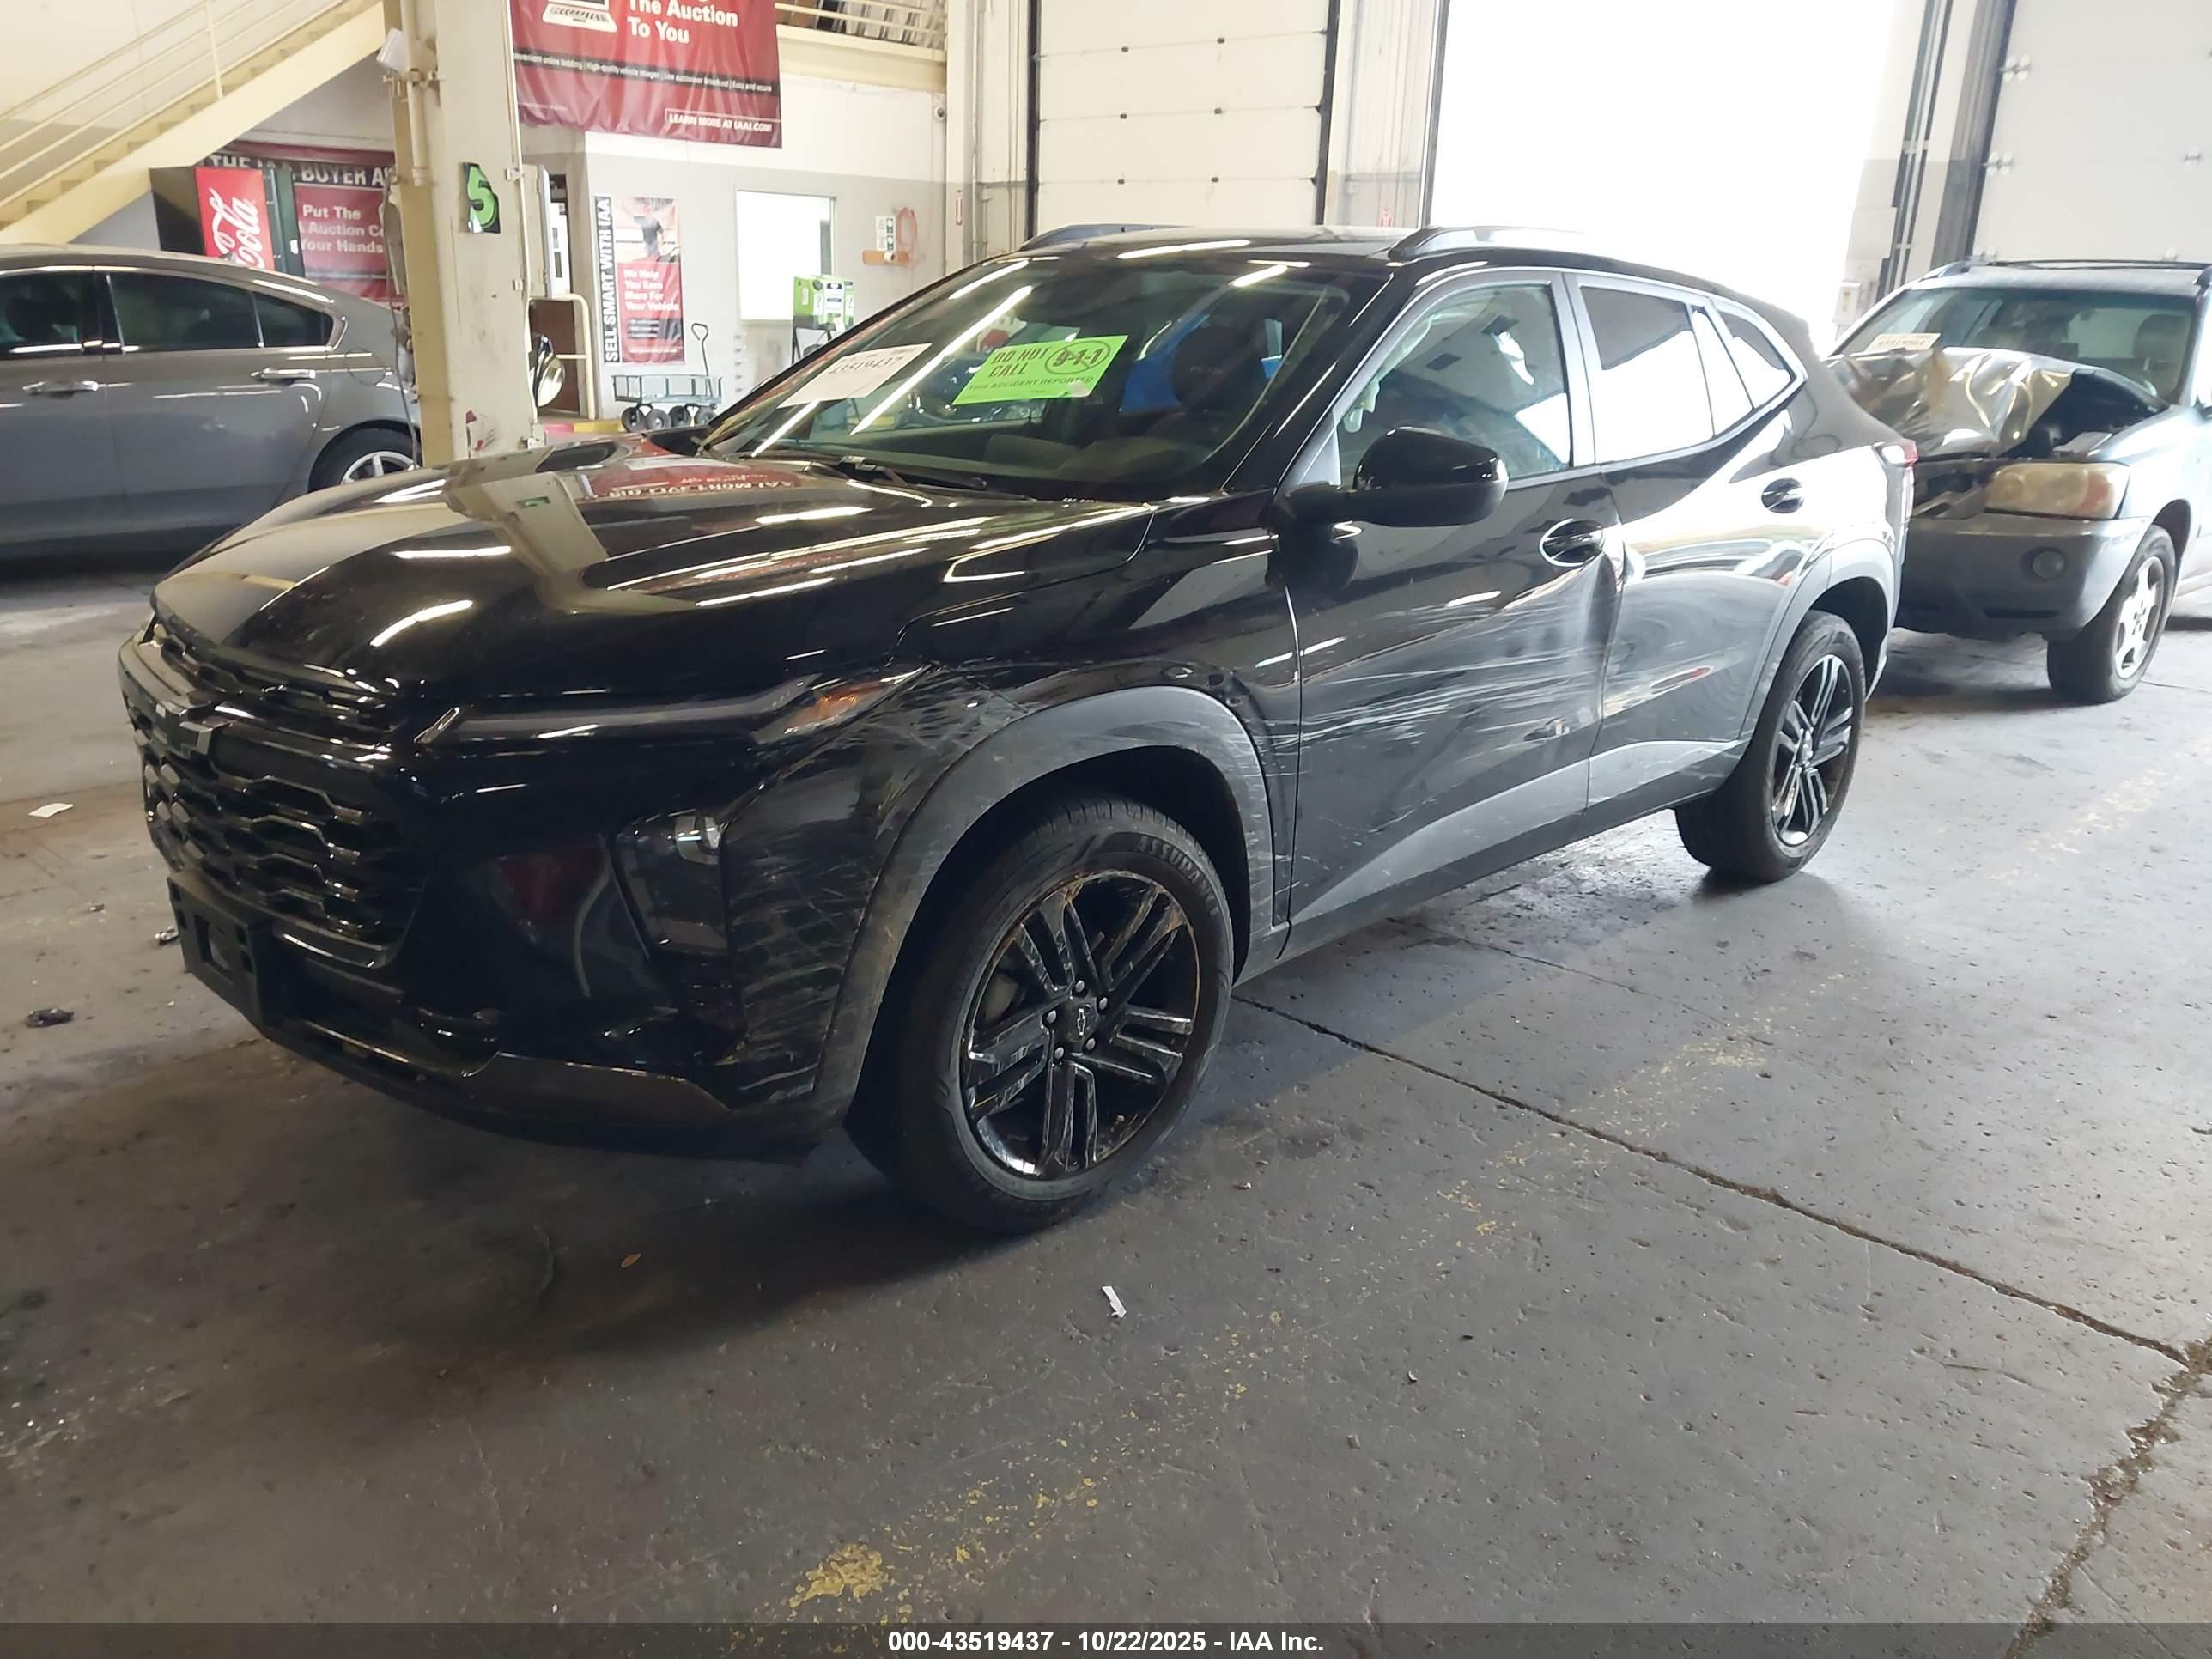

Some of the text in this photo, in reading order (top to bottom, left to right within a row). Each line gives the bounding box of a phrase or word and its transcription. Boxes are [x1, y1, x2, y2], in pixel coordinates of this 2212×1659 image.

[629, 0, 738, 27] The Auction
[627, 16, 690, 44] To You
[467, 165, 496, 228] 5
[302, 204, 361, 221] Put The
[309, 222, 365, 236] Auction
[337, 239, 384, 253] Hands
[596, 198, 619, 362] SELL SMART WITH IAA
[991, 347, 1105, 368] DO NOT 9-1-1
[988, 363, 1027, 379] CALL
